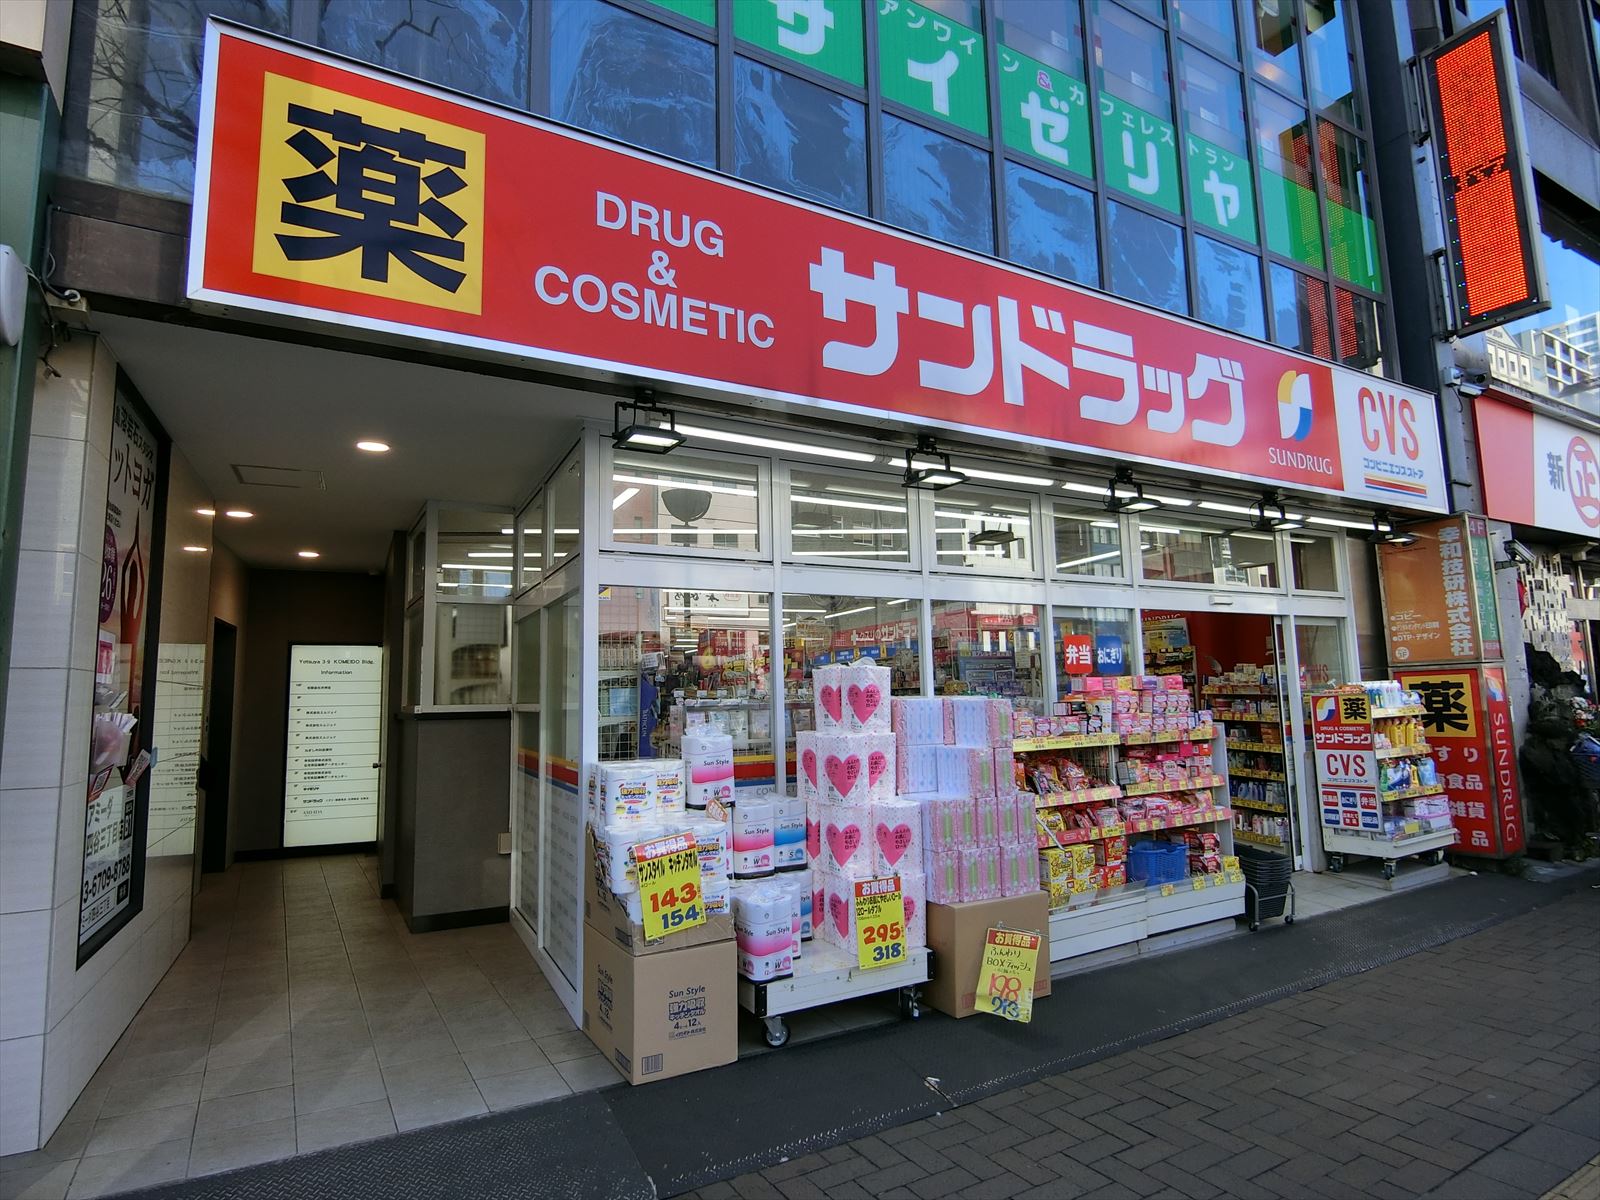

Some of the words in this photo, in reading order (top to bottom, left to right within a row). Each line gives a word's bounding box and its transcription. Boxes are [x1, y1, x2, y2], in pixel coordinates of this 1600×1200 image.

[768, 0, 1240, 227] サイゼリヤ
[274, 103, 467, 293] 薬
[597, 190, 726, 258] DRUG
[648, 249, 677, 288] &
[534, 264, 775, 350] COSMETIC
[808, 246, 1246, 447] サンドラッグ
[1358, 387, 1420, 460] CVS
[1268, 446, 1334, 476] SUNDRUG
[1363, 457, 1424, 479] コンビニエンスストア
[1547, 451, 1566, 492] 新
[1065, 645, 1092, 665] 弁当
[1097, 646, 1122, 664] おにぎり
[1342, 697, 1367, 720] 薬
[1409, 680, 1470, 732] 薬
[1316, 732, 1371, 745] サンドラッグ
[716, 758, 730, 767] Style
[1326, 753, 1366, 777] CVS
[1493, 712, 1517, 843] SUNDRUG
[756, 826, 770, 835] Style
[791, 822, 804, 830] Style
[638, 857, 666, 883] サンスタイル
[650, 882, 697, 913] 143
[862, 879, 896, 896] お買得品
[661, 904, 700, 929] 154
[777, 926, 790, 935] Style
[863, 921, 901, 945] 295
[995, 932, 1031, 947] お買得品
[873, 943, 902, 962] 318
[990, 947, 1021, 958] ふんわり
[669, 990, 684, 999] Sun
[686, 984, 706, 998] Style
[989, 972, 1022, 1001] 198
